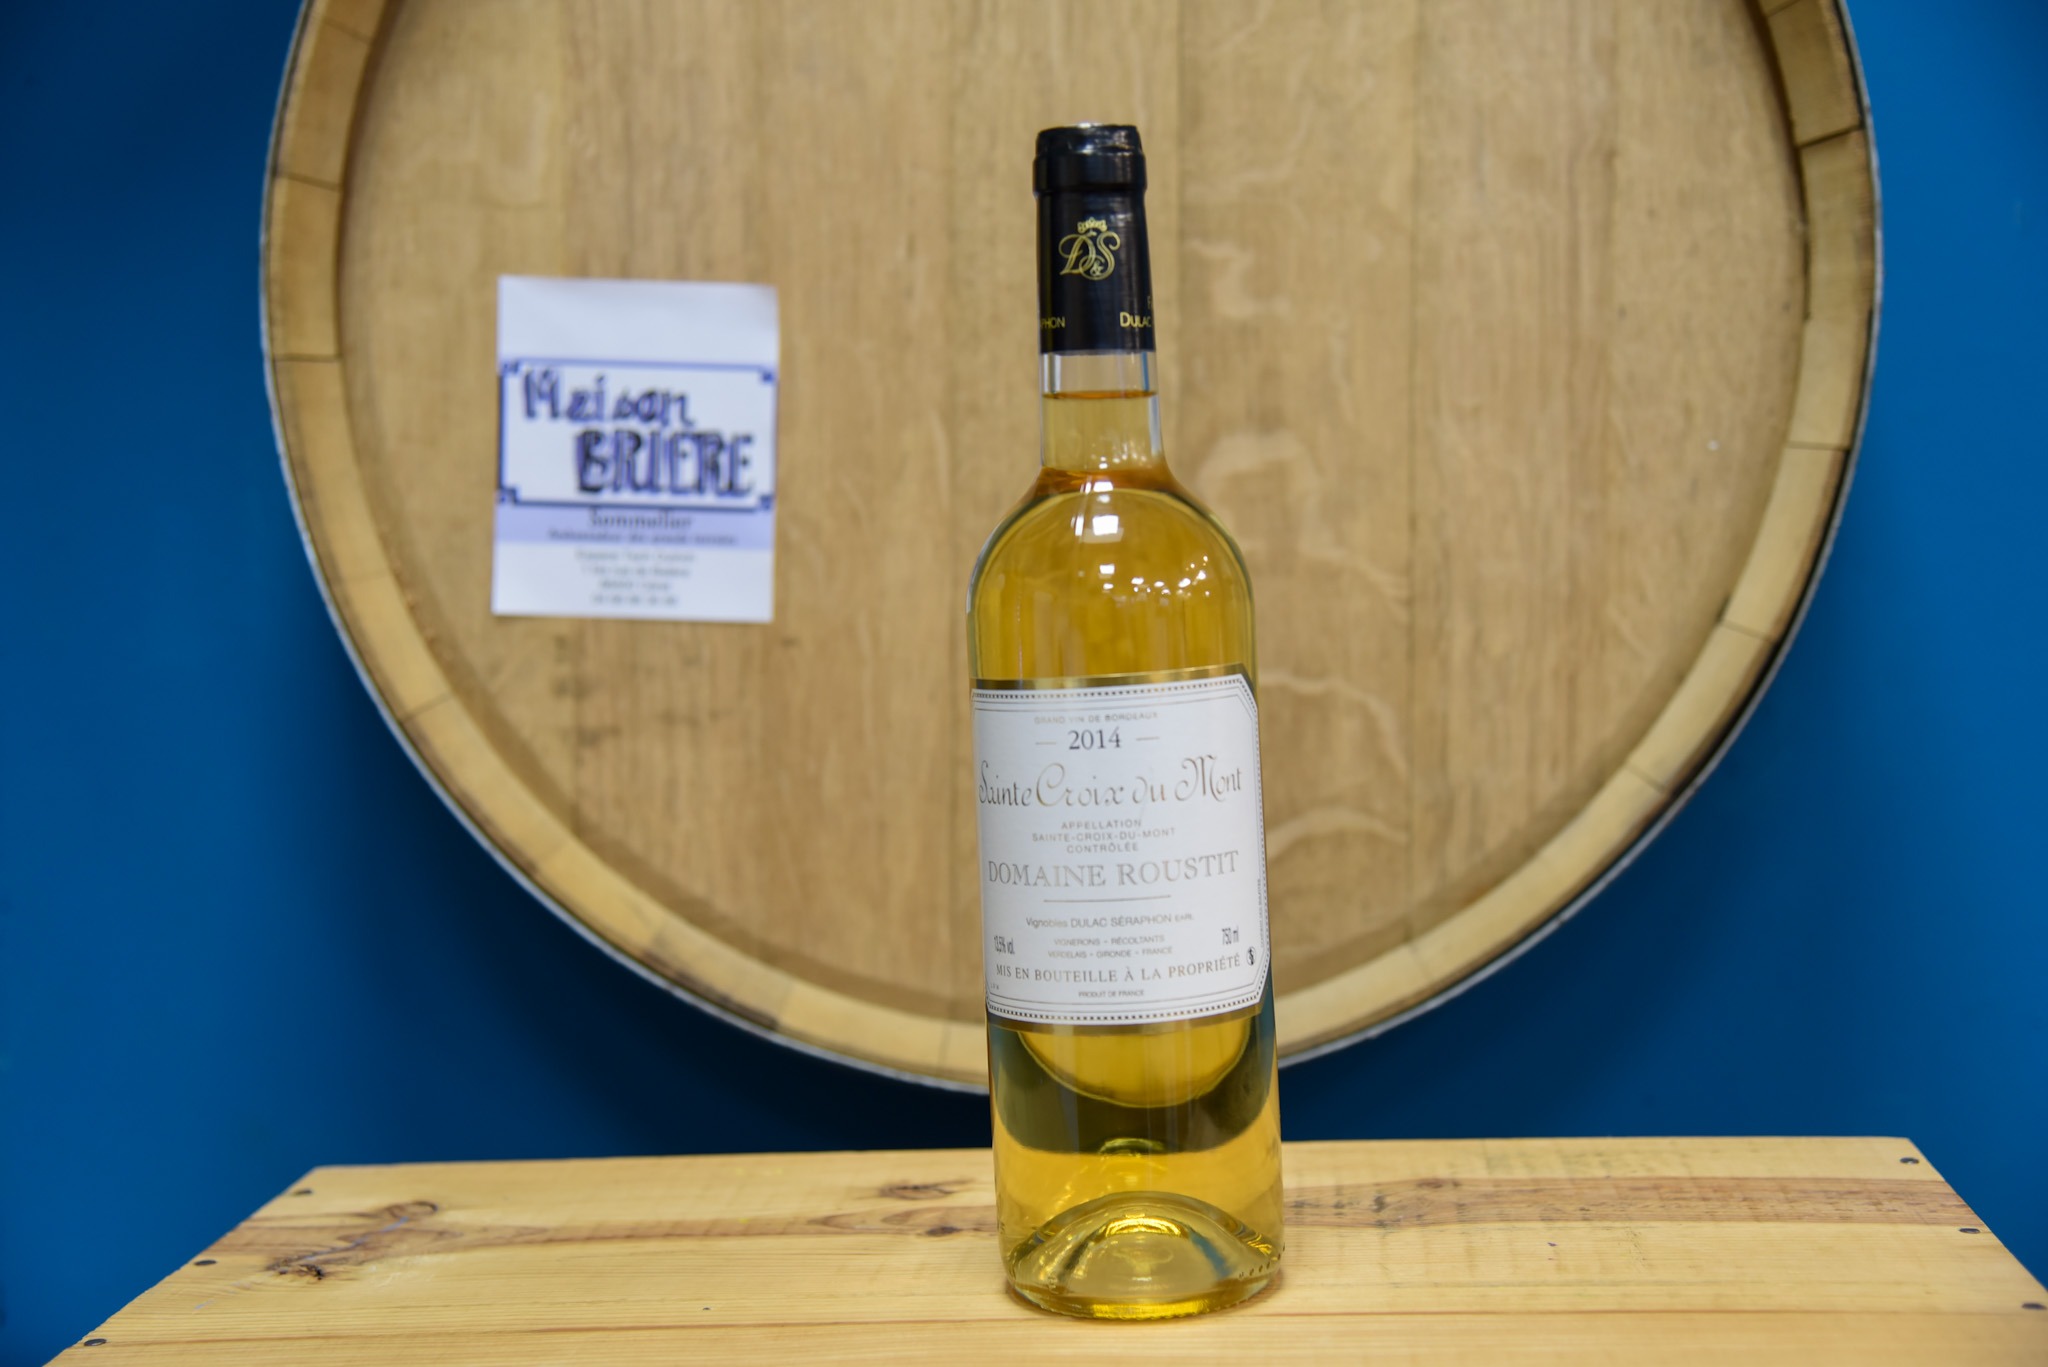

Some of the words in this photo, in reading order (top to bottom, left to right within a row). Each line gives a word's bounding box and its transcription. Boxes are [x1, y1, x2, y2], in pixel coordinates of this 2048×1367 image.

[1104, 711, 1158, 722] BORDEAUX
[1067, 725, 1122, 750] 2014
[978, 759, 1032, 807] Sainte
[1036, 762, 1125, 807] Croix
[1132, 775, 1166, 804] du
[1174, 754, 1242, 803] Mont
[1060, 818, 1142, 830] APPELLATION
[1032, 827, 1175, 842] SAINTE-CROIX-DU-MONT
[1066, 842, 1138, 854] CONTRÔLÉE
[988, 860, 1106, 887] DOMAINE
[1116, 849, 1239, 886] ROUSTIT
[1026, 917, 1068, 929] Vignobles
[1070, 917, 1107, 928] DULAC
[1110, 913, 1172, 928] SÉRAPHON
[1142, 946, 1173, 955] FRANCE
[996, 963, 1012, 978] MIS
[1015, 967, 1029, 980] EN
[1035, 969, 1118, 983] BOUTEILLE
[1124, 966, 1134, 981] À
[1141, 968, 1162, 981] LA
[1168, 954, 1241, 979] PROPRIÉTÉ
